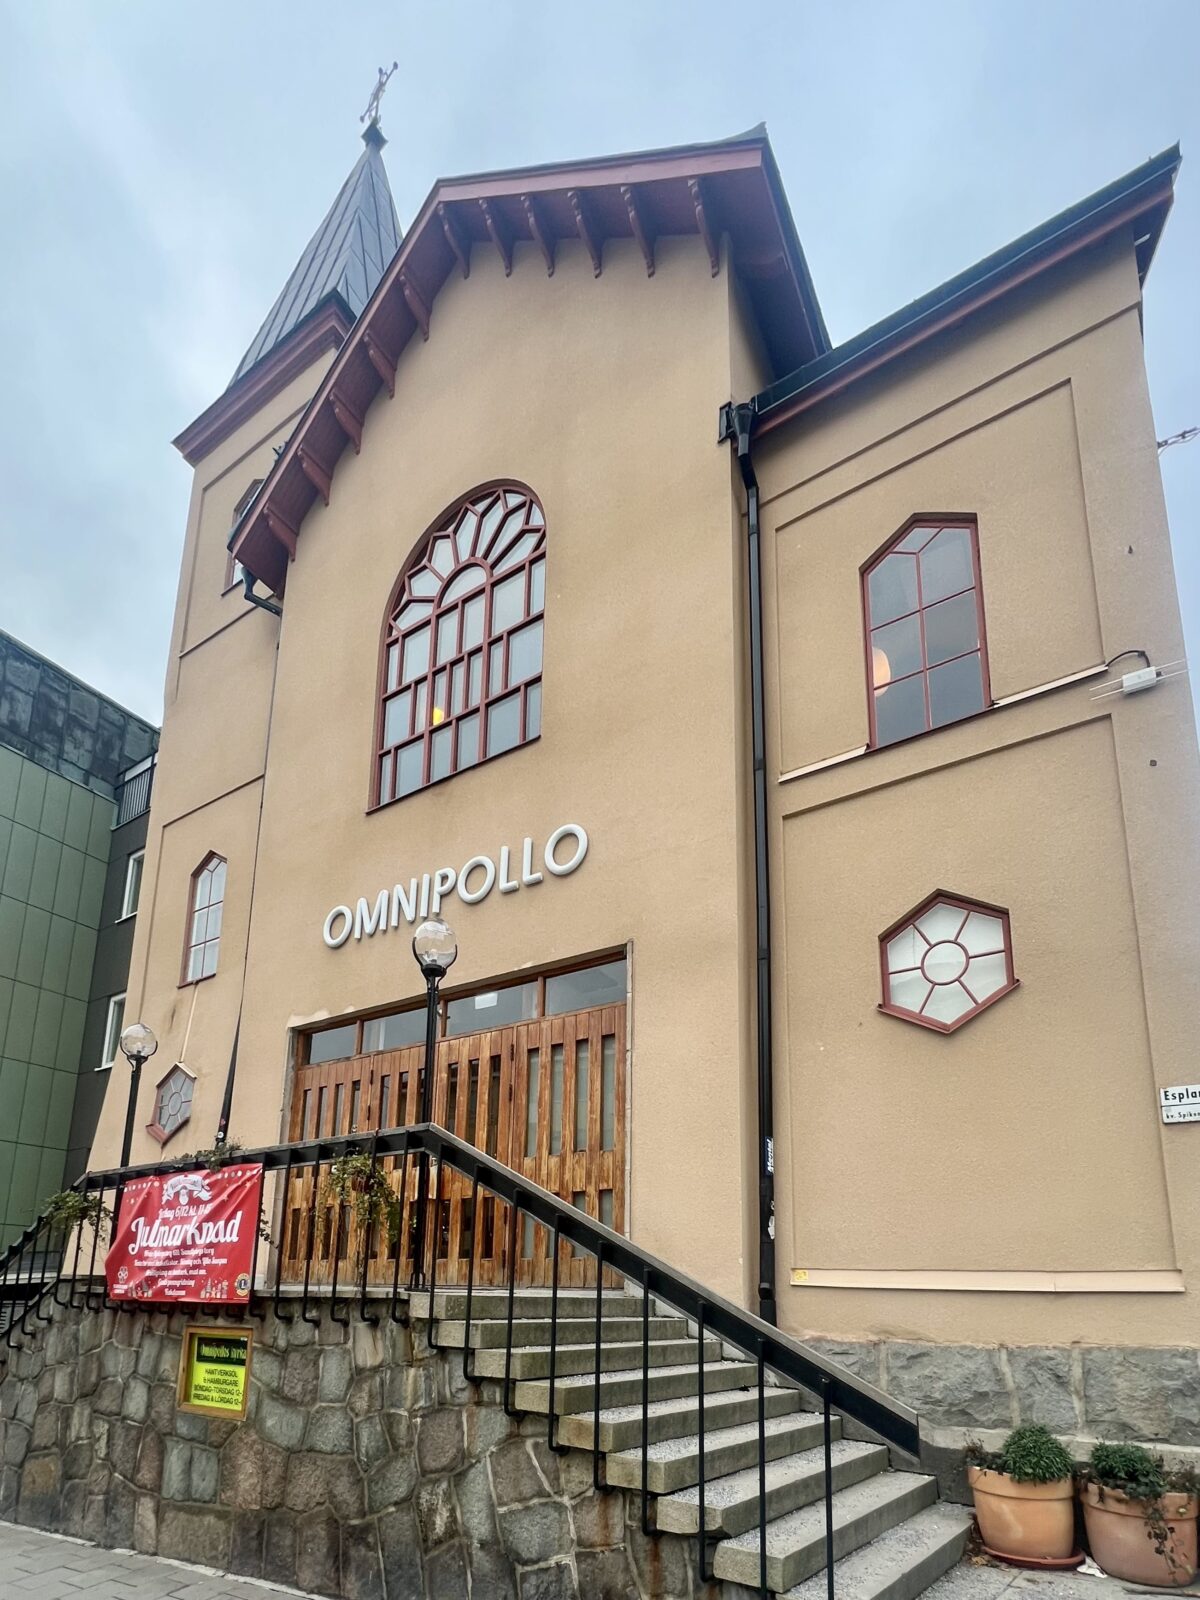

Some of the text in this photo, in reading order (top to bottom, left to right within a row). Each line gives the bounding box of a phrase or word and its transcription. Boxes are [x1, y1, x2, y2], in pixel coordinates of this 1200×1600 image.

[323, 823, 589, 948] OMNIPOLLO
[175, 1205, 188, 1219] 6/12
[207, 1378, 239, 1387] HAMBURGARE
